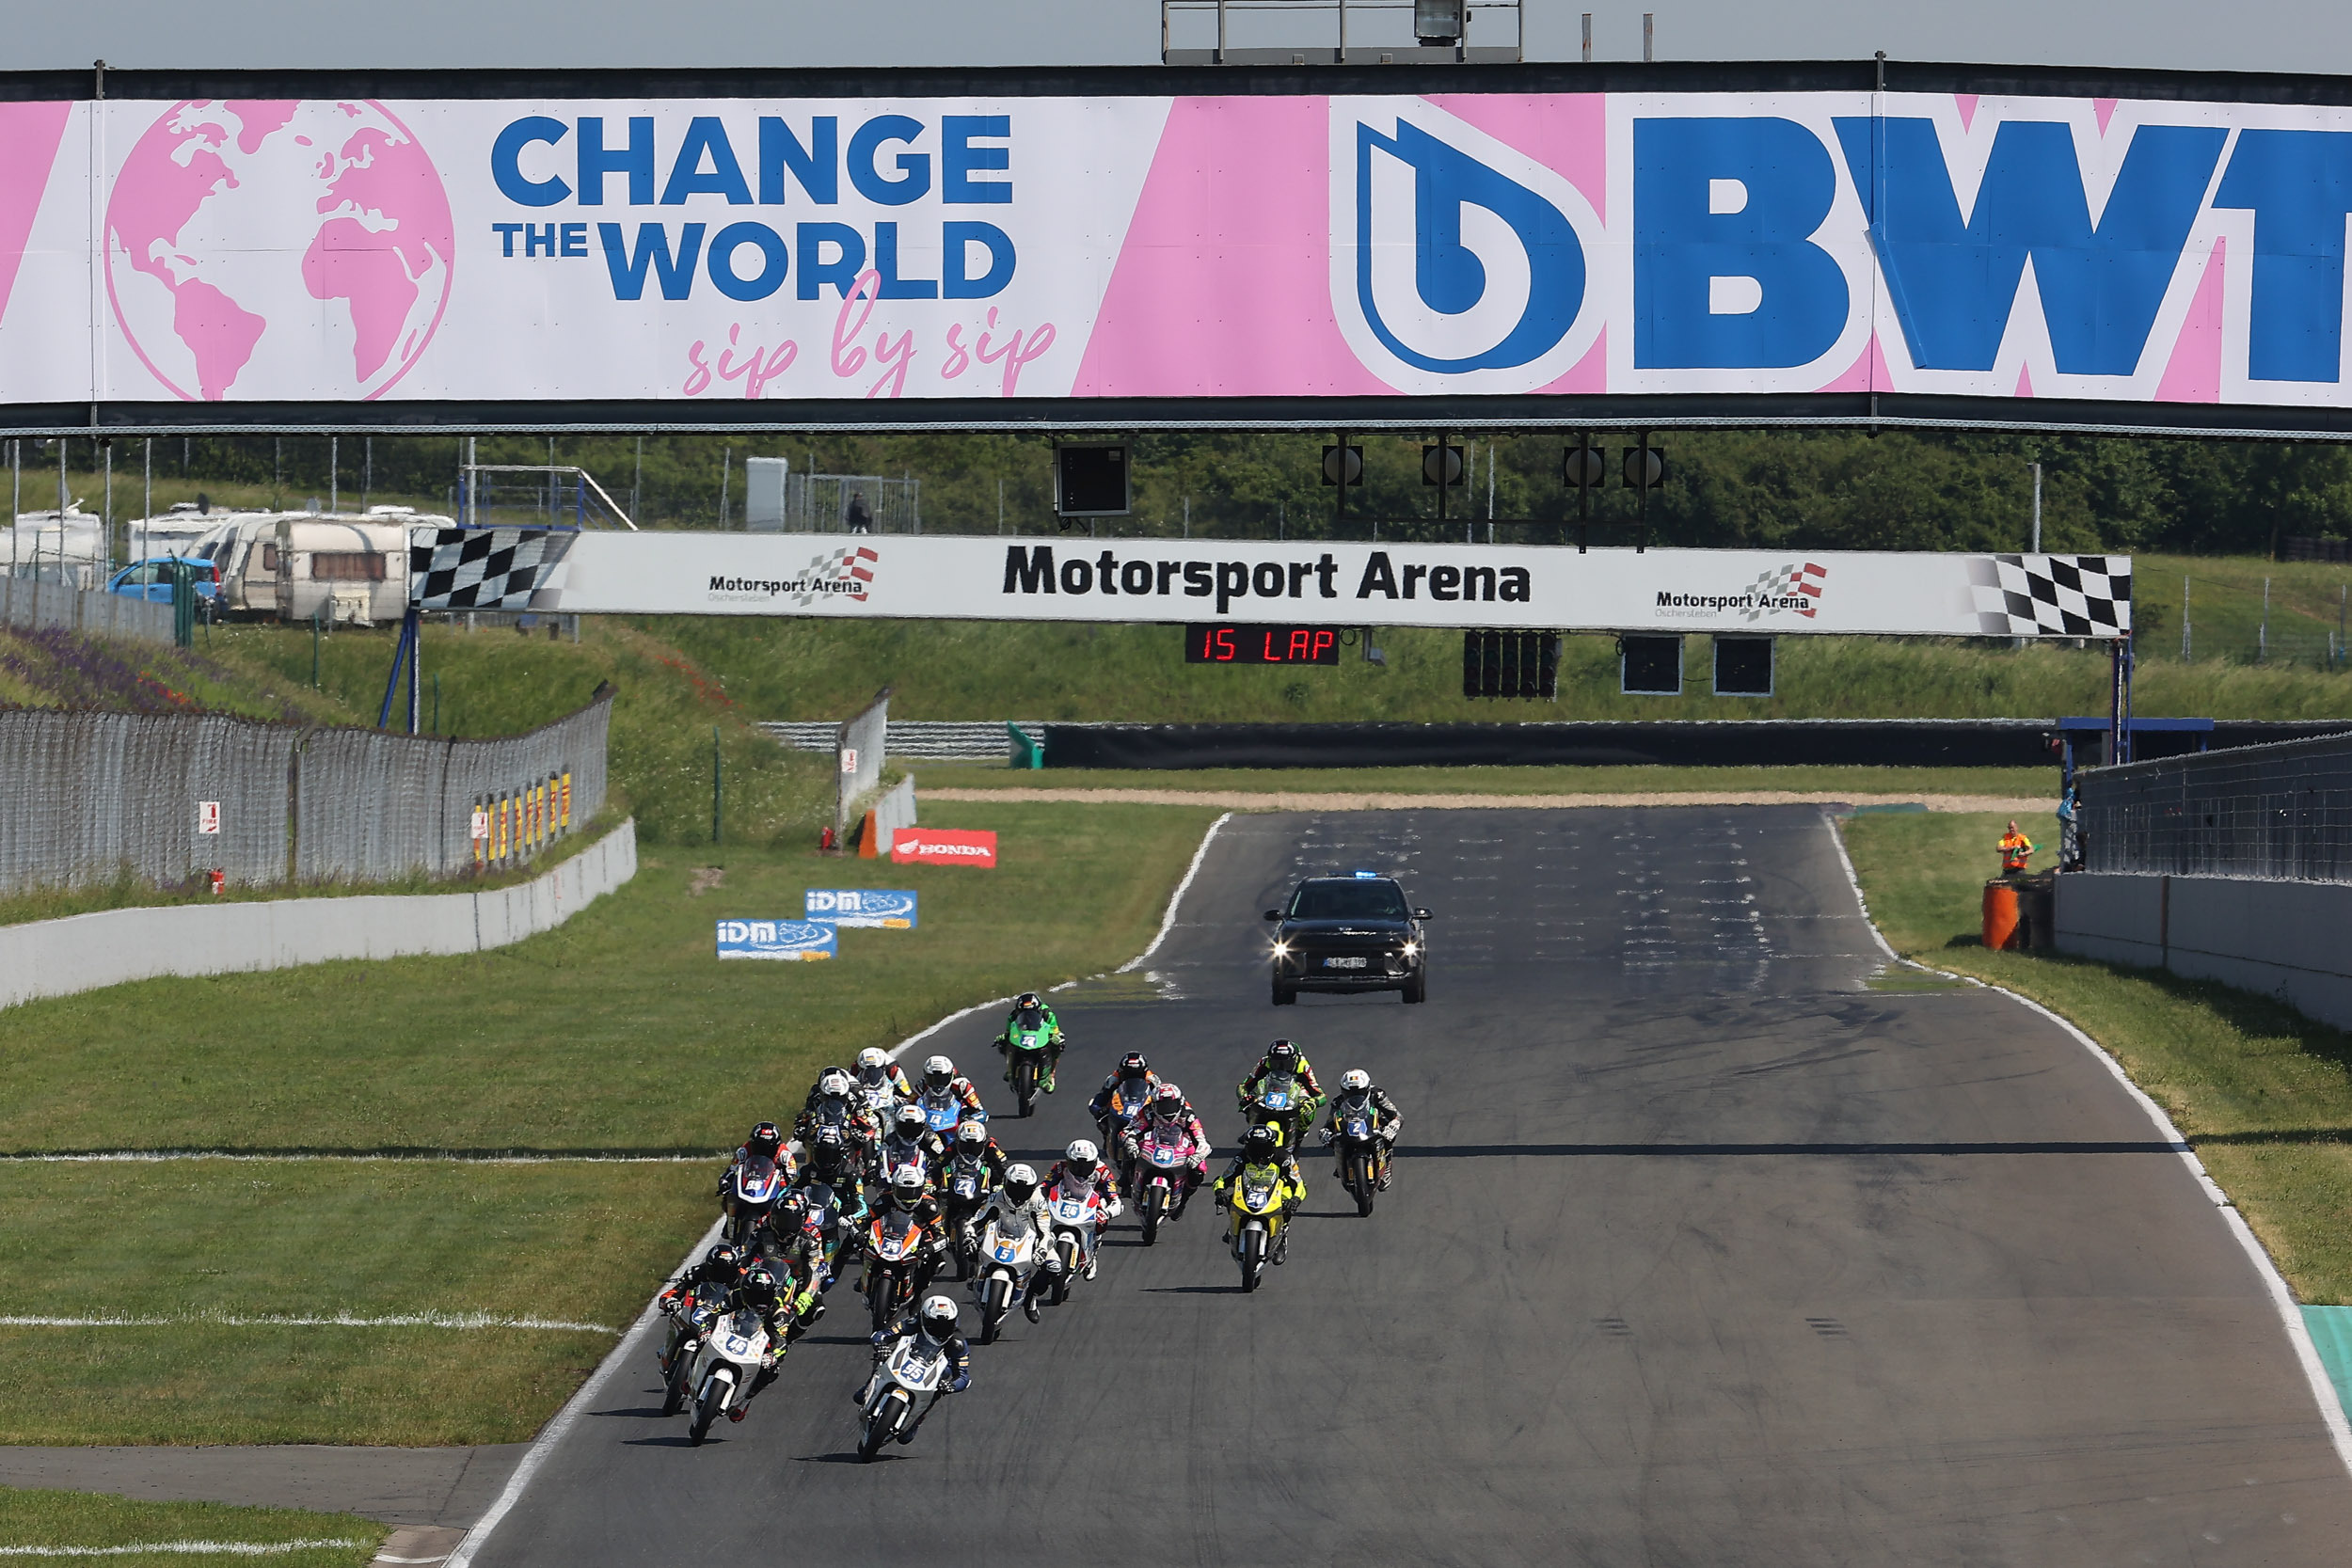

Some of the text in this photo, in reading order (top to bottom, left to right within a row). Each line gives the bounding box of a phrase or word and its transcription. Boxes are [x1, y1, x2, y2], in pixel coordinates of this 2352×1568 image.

[491, 115, 1012, 206] CHANGE
[1634, 117, 2352, 384] BWT
[492, 221, 1016, 301] THE WORLD
[683, 269, 1056, 399] sip by sip
[709, 576, 863, 595] Motorsport Arena
[1003, 546, 1531, 613] Motorsport Arena
[1657, 592, 1809, 611] Motorsport Arena
[1655, 609, 1717, 618] Oschersleben
[1204, 629, 1333, 660] 15 LAP
[918, 844, 992, 857] HONDA
[1269, 1094, 1283, 1106] 31
[1063, 1204, 1079, 1217] 96
[999, 1249, 1009, 1259] 5
[727, 1338, 746, 1351] 46
[902, 1363, 924, 1380] 95
